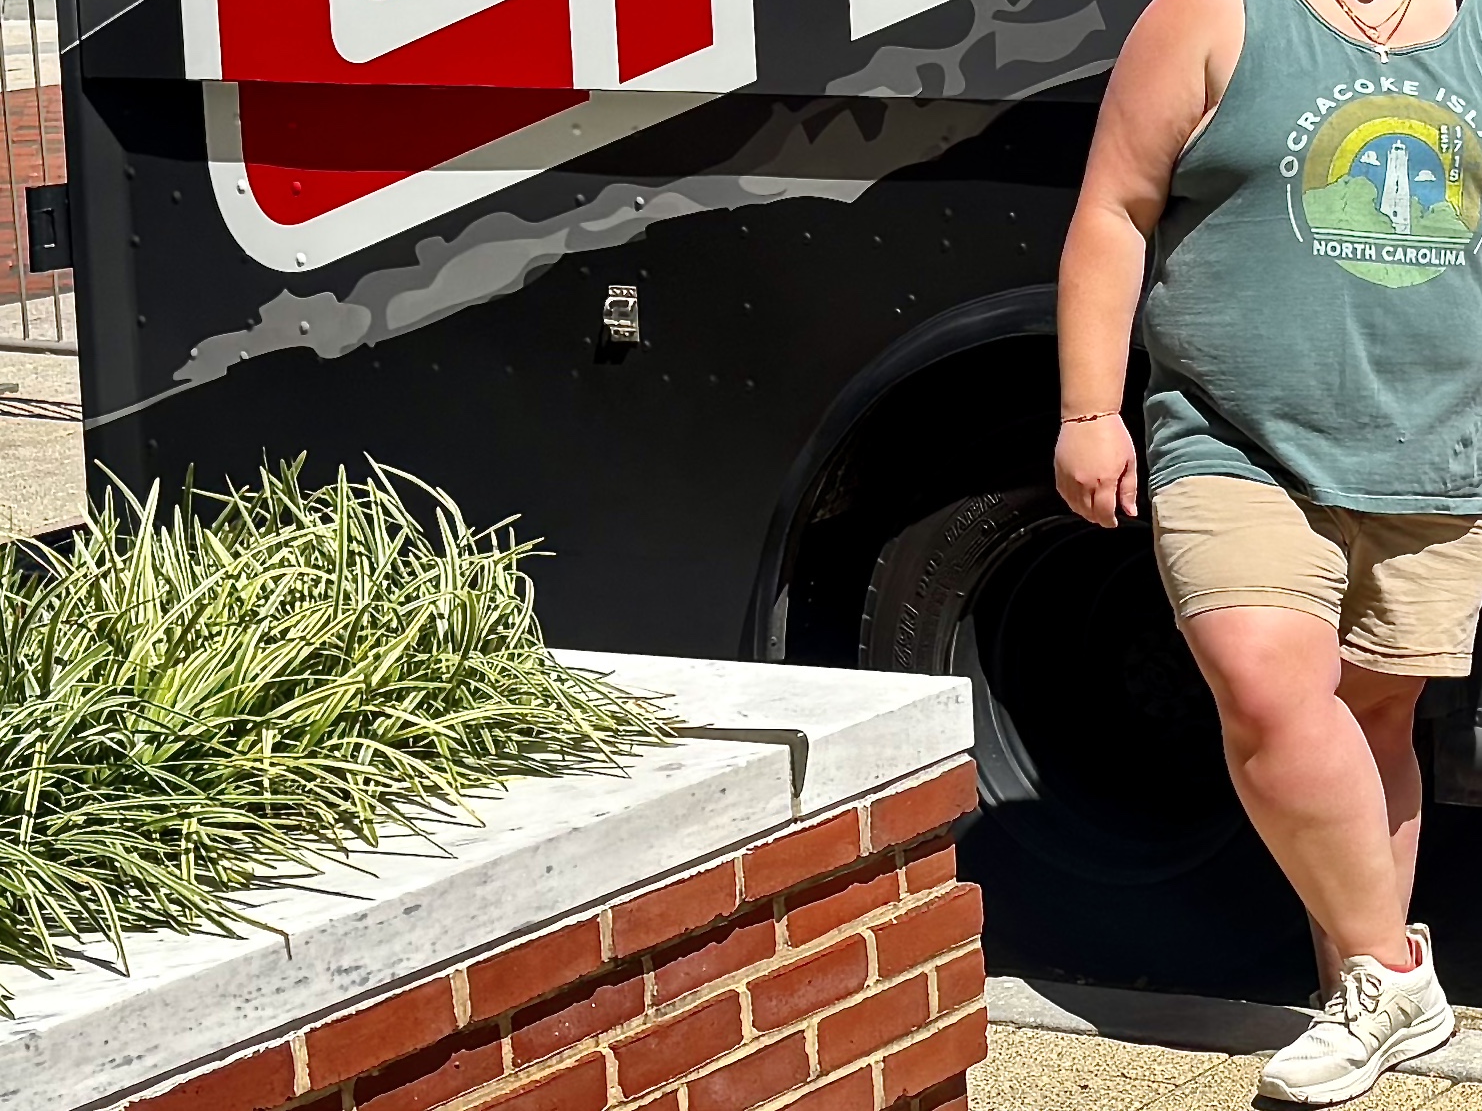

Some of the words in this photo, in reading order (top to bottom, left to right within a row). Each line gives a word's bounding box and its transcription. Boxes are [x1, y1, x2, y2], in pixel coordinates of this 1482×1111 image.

[1279, 76, 1420, 179] OCRACOKE
[1312, 239, 1376, 261] NORTH
[1381, 245, 1466, 266] CAROLINA
